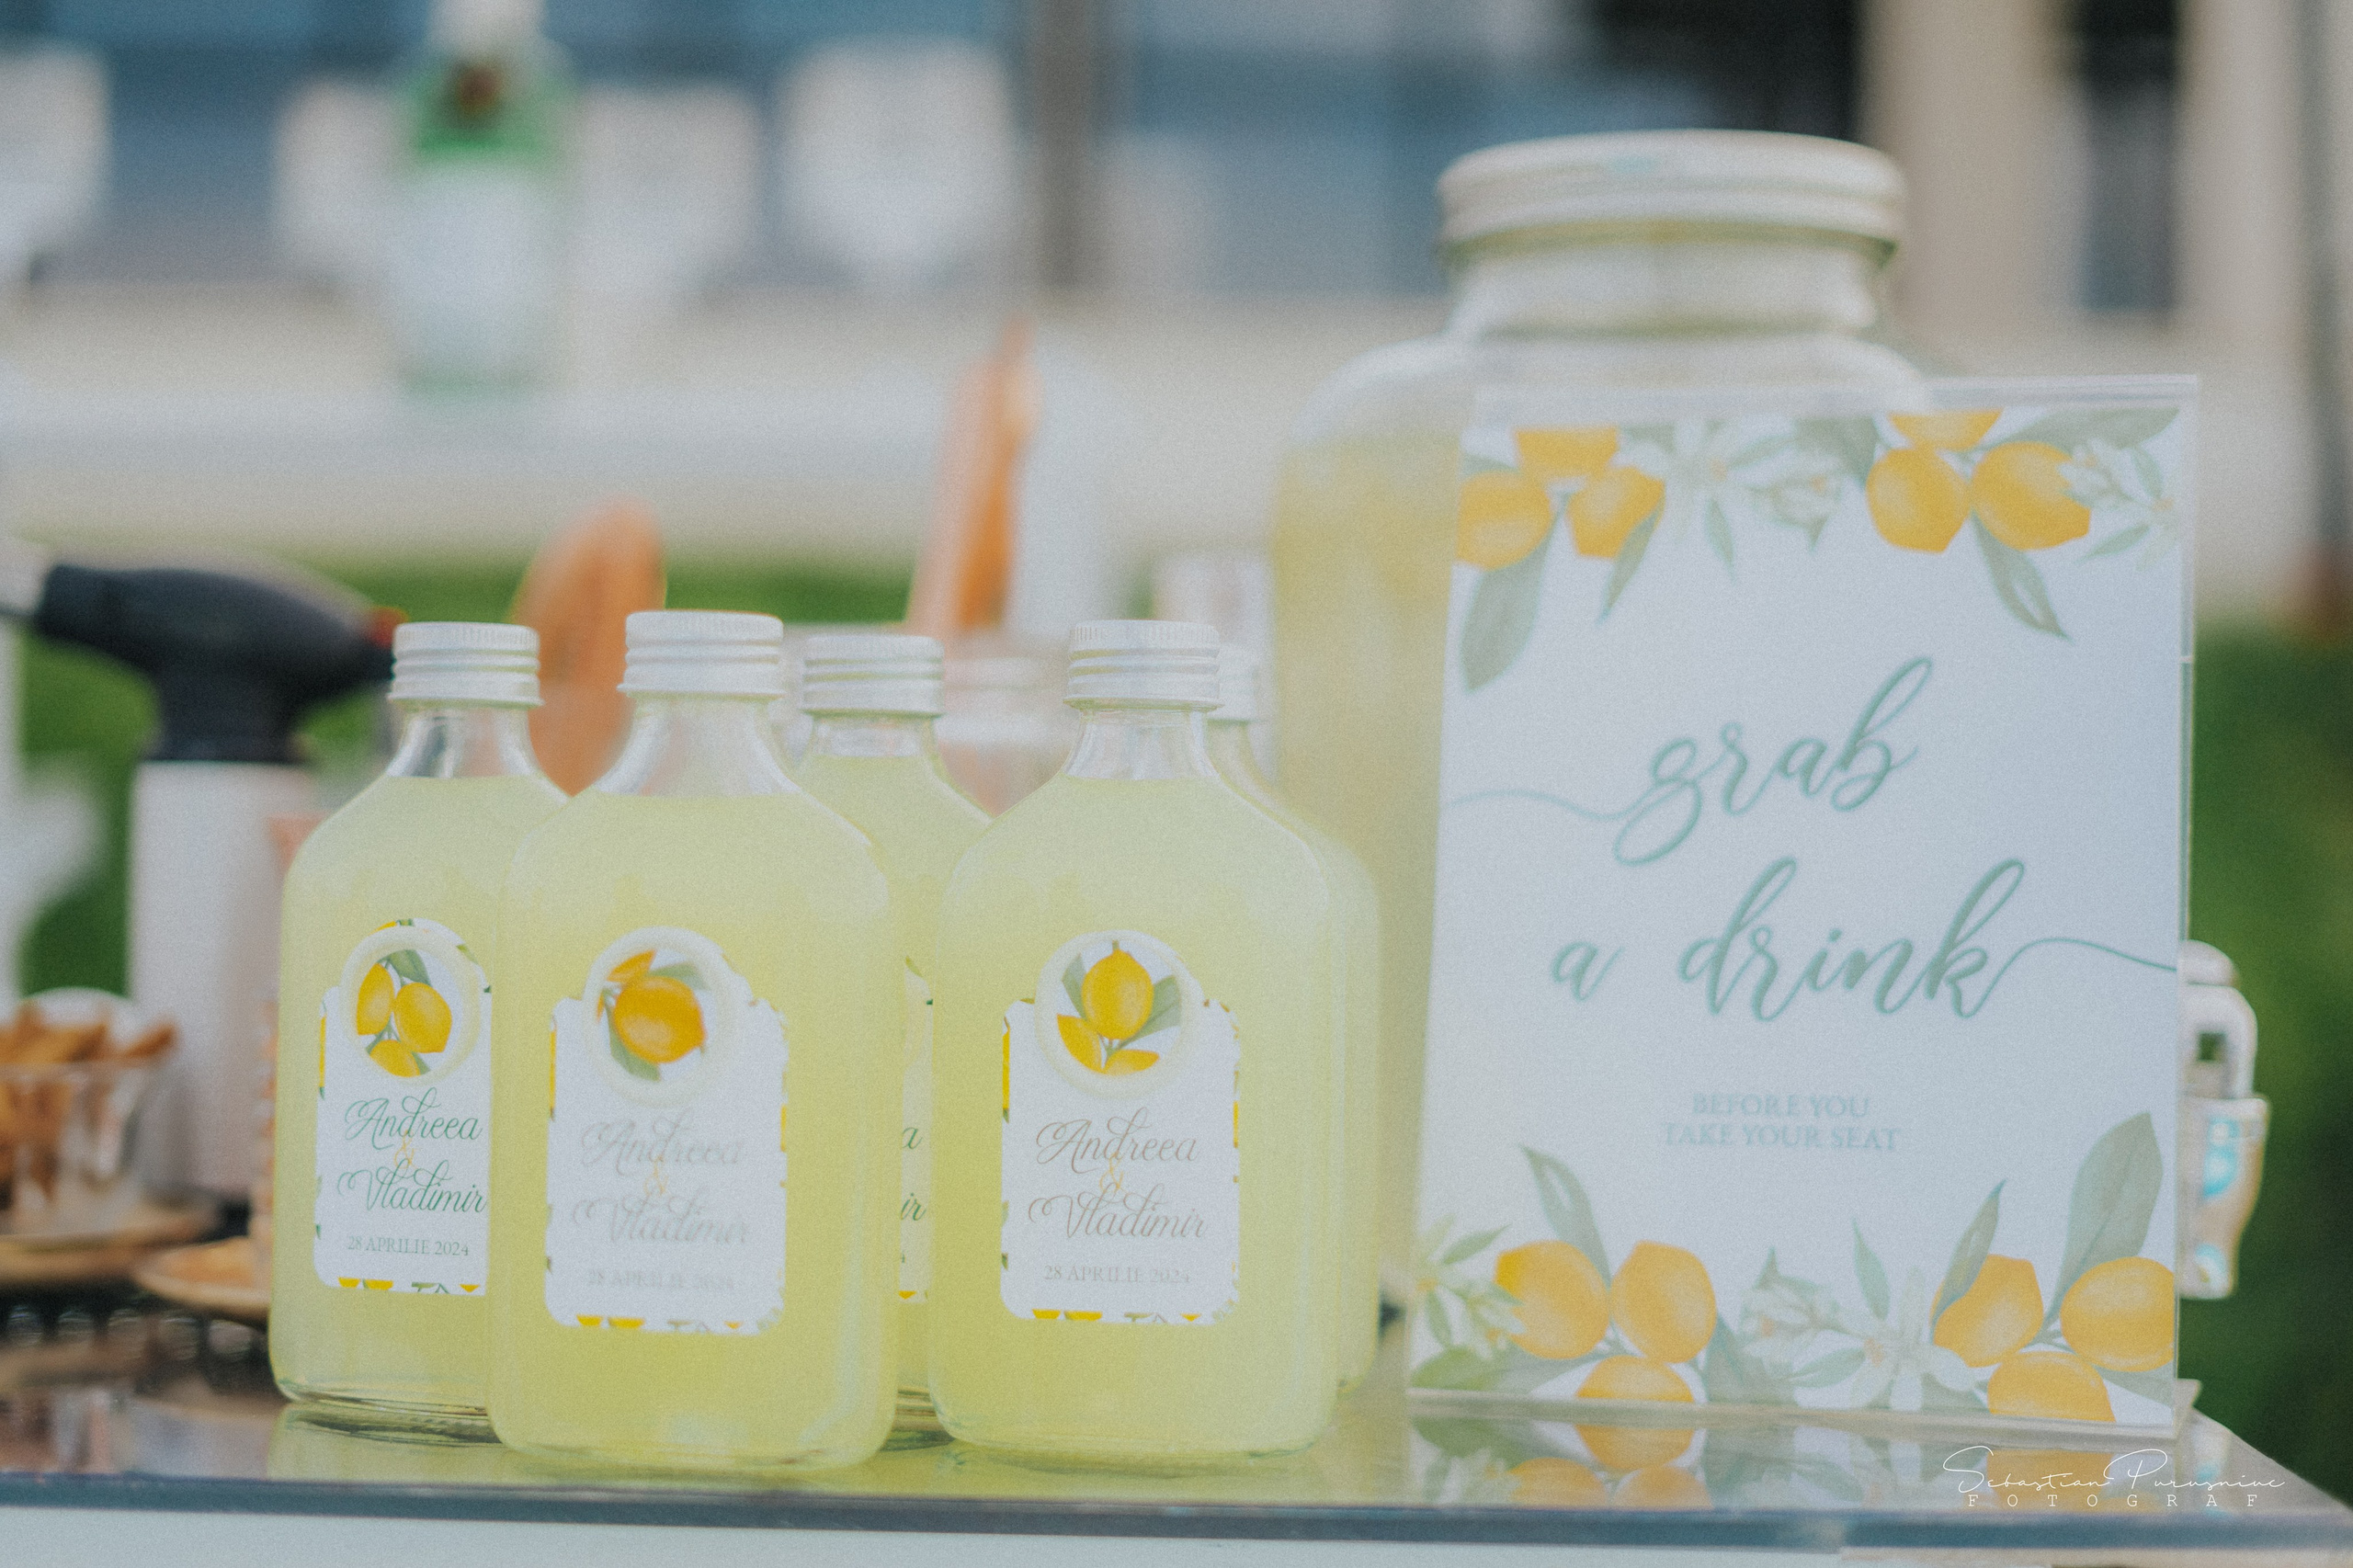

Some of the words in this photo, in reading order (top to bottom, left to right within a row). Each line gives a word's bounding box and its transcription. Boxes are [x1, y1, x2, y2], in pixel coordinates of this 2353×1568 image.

[1449, 655, 1933, 867] grab
[1549, 941, 1625, 1003] a
[1677, 857, 2178, 1023] drink
[344, 1086, 483, 1151] Andreea
[1692, 1092, 1802, 1118] BEFORE
[1809, 1094, 1871, 1119] YOU
[1035, 1106, 1201, 1175] Andreea
[1661, 1121, 1733, 1147] TAKE
[1742, 1123, 1824, 1149] YOUR
[1831, 1126, 1903, 1151] SEAT
[336, 1158, 488, 1213] Vladimir
[1028, 1182, 1207, 1239] Vladimir
[347, 1235, 362, 1251] 28
[365, 1236, 430, 1256] APRILIE
[434, 1241, 470, 1256] 2024
[1043, 1265, 1063, 1281] 28
